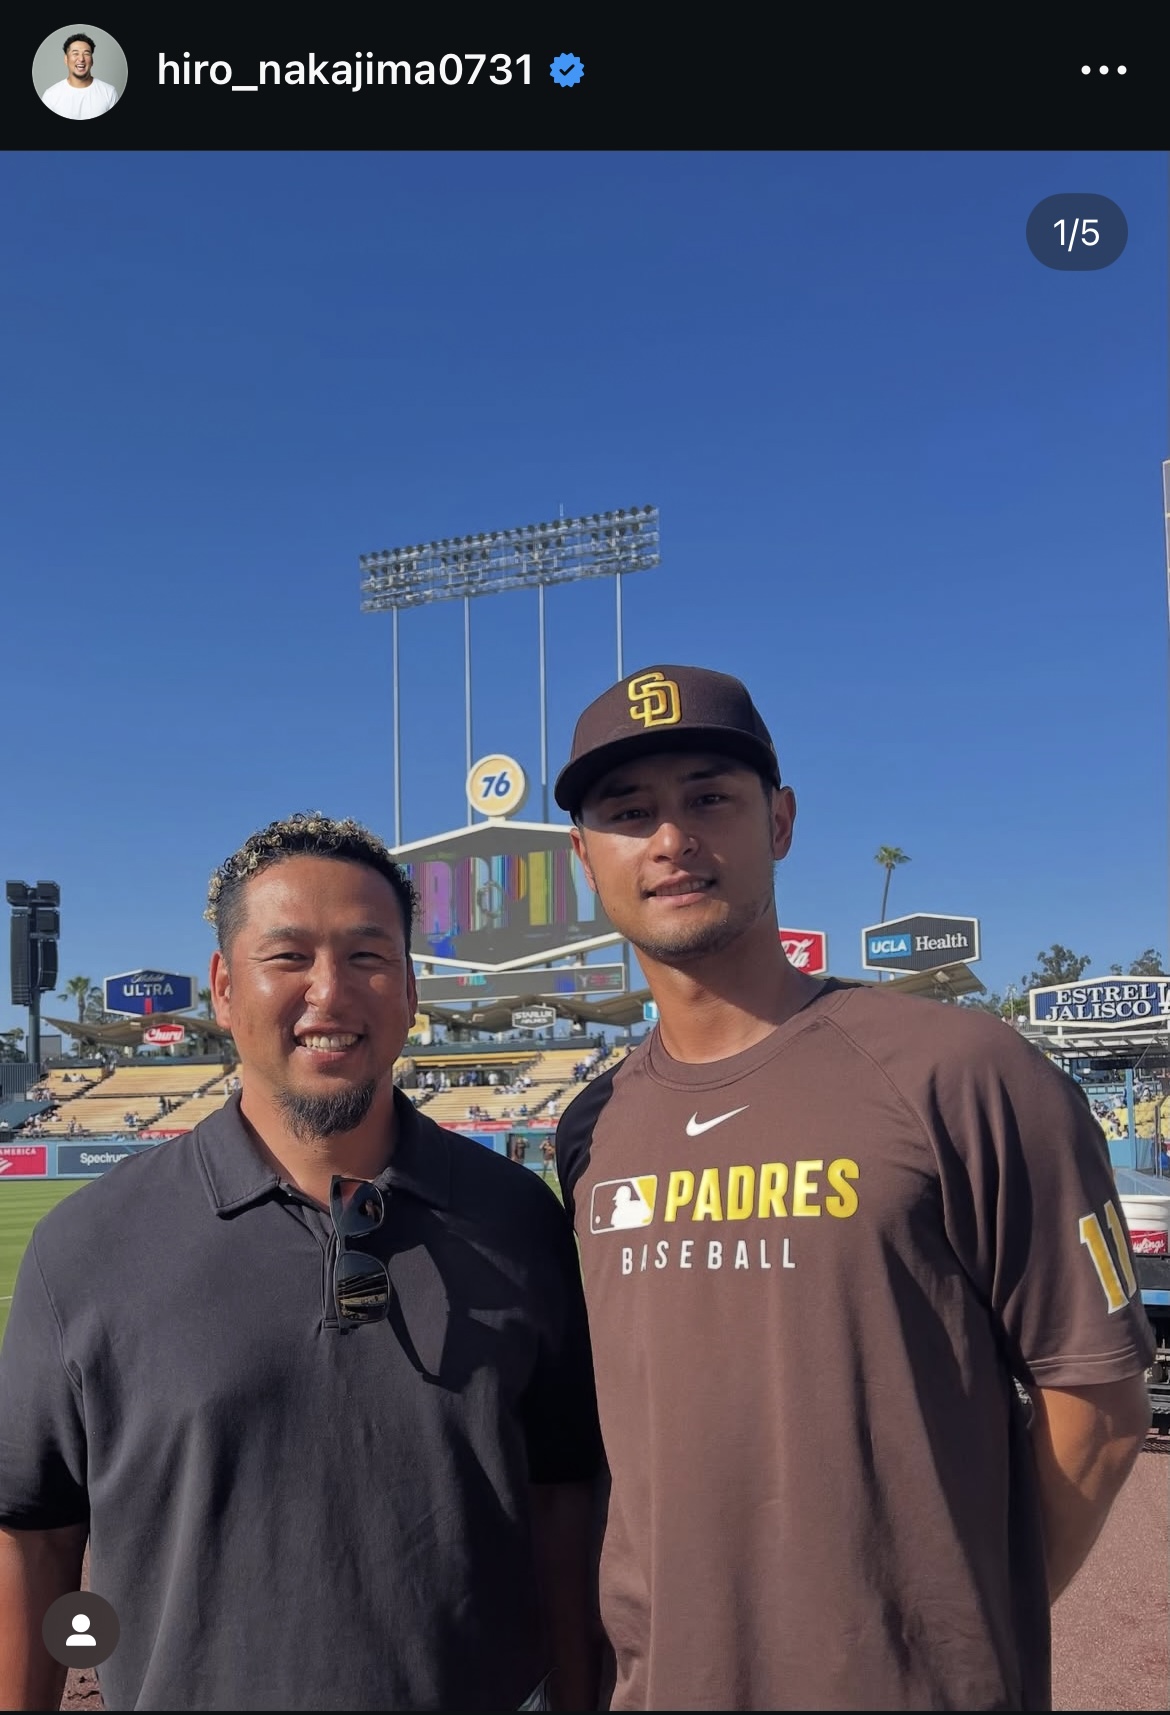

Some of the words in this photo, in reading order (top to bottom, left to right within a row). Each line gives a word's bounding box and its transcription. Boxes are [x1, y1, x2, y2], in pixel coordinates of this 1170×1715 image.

[627, 671, 682, 728] SD
[481, 771, 511, 798] 76
[871, 940, 908, 954] UCLA
[915, 933, 968, 951] Health
[123, 983, 174, 997] ULTRA
[1045, 1000, 1152, 1022] JALISCO
[663, 1158, 861, 1222] PADRES
[621, 1238, 796, 1275] BASEBALL
[1079, 1200, 1137, 1314] 11
